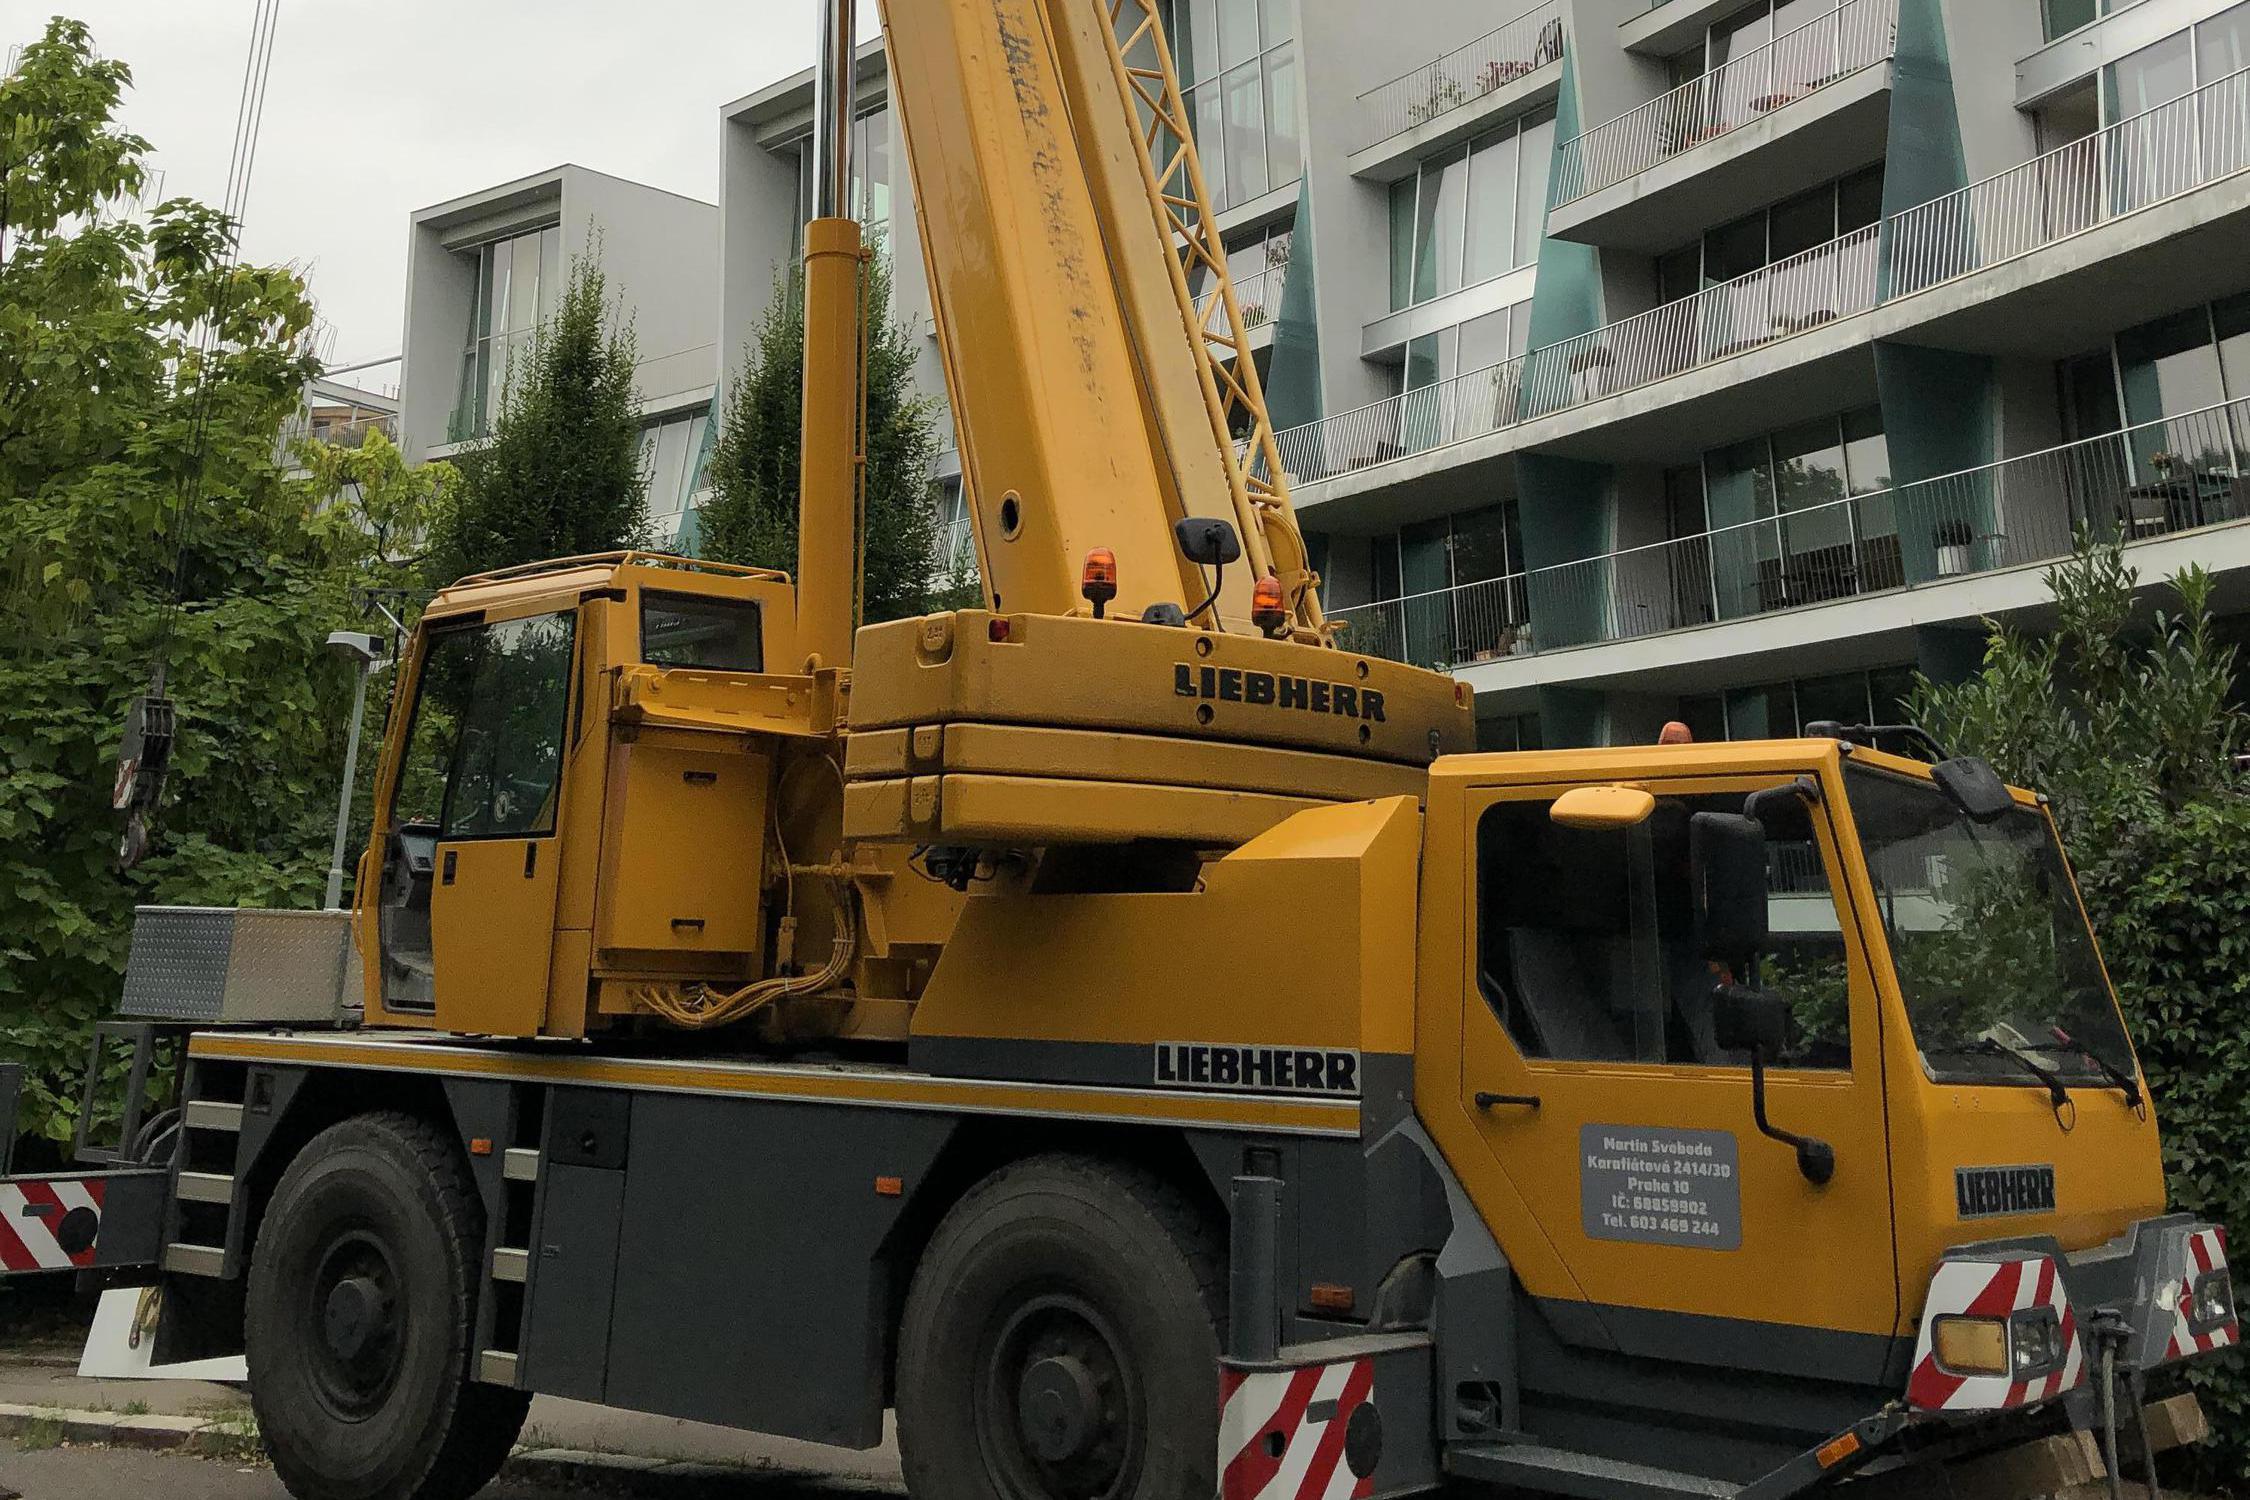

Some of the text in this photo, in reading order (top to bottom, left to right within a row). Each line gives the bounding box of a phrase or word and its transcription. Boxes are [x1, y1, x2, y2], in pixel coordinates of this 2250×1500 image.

[1174, 662, 1386, 722] LIEBHERR
[1157, 1045, 1357, 1090] LIEBHERR
[1603, 1137, 1713, 1156] Martin Svoboda
[1587, 1155, 1731, 1178] Karafiátová 2414/30
[1628, 1176, 1690, 1194] Praha 10
[1956, 1168, 2055, 1215] LIEBHERR
[1611, 1191, 1630, 1209] IČ:
[1602, 1213, 1627, 1228] Tel.
[1630, 1215, 1657, 1230] 603
[1692, 1221, 1719, 1236] 244
